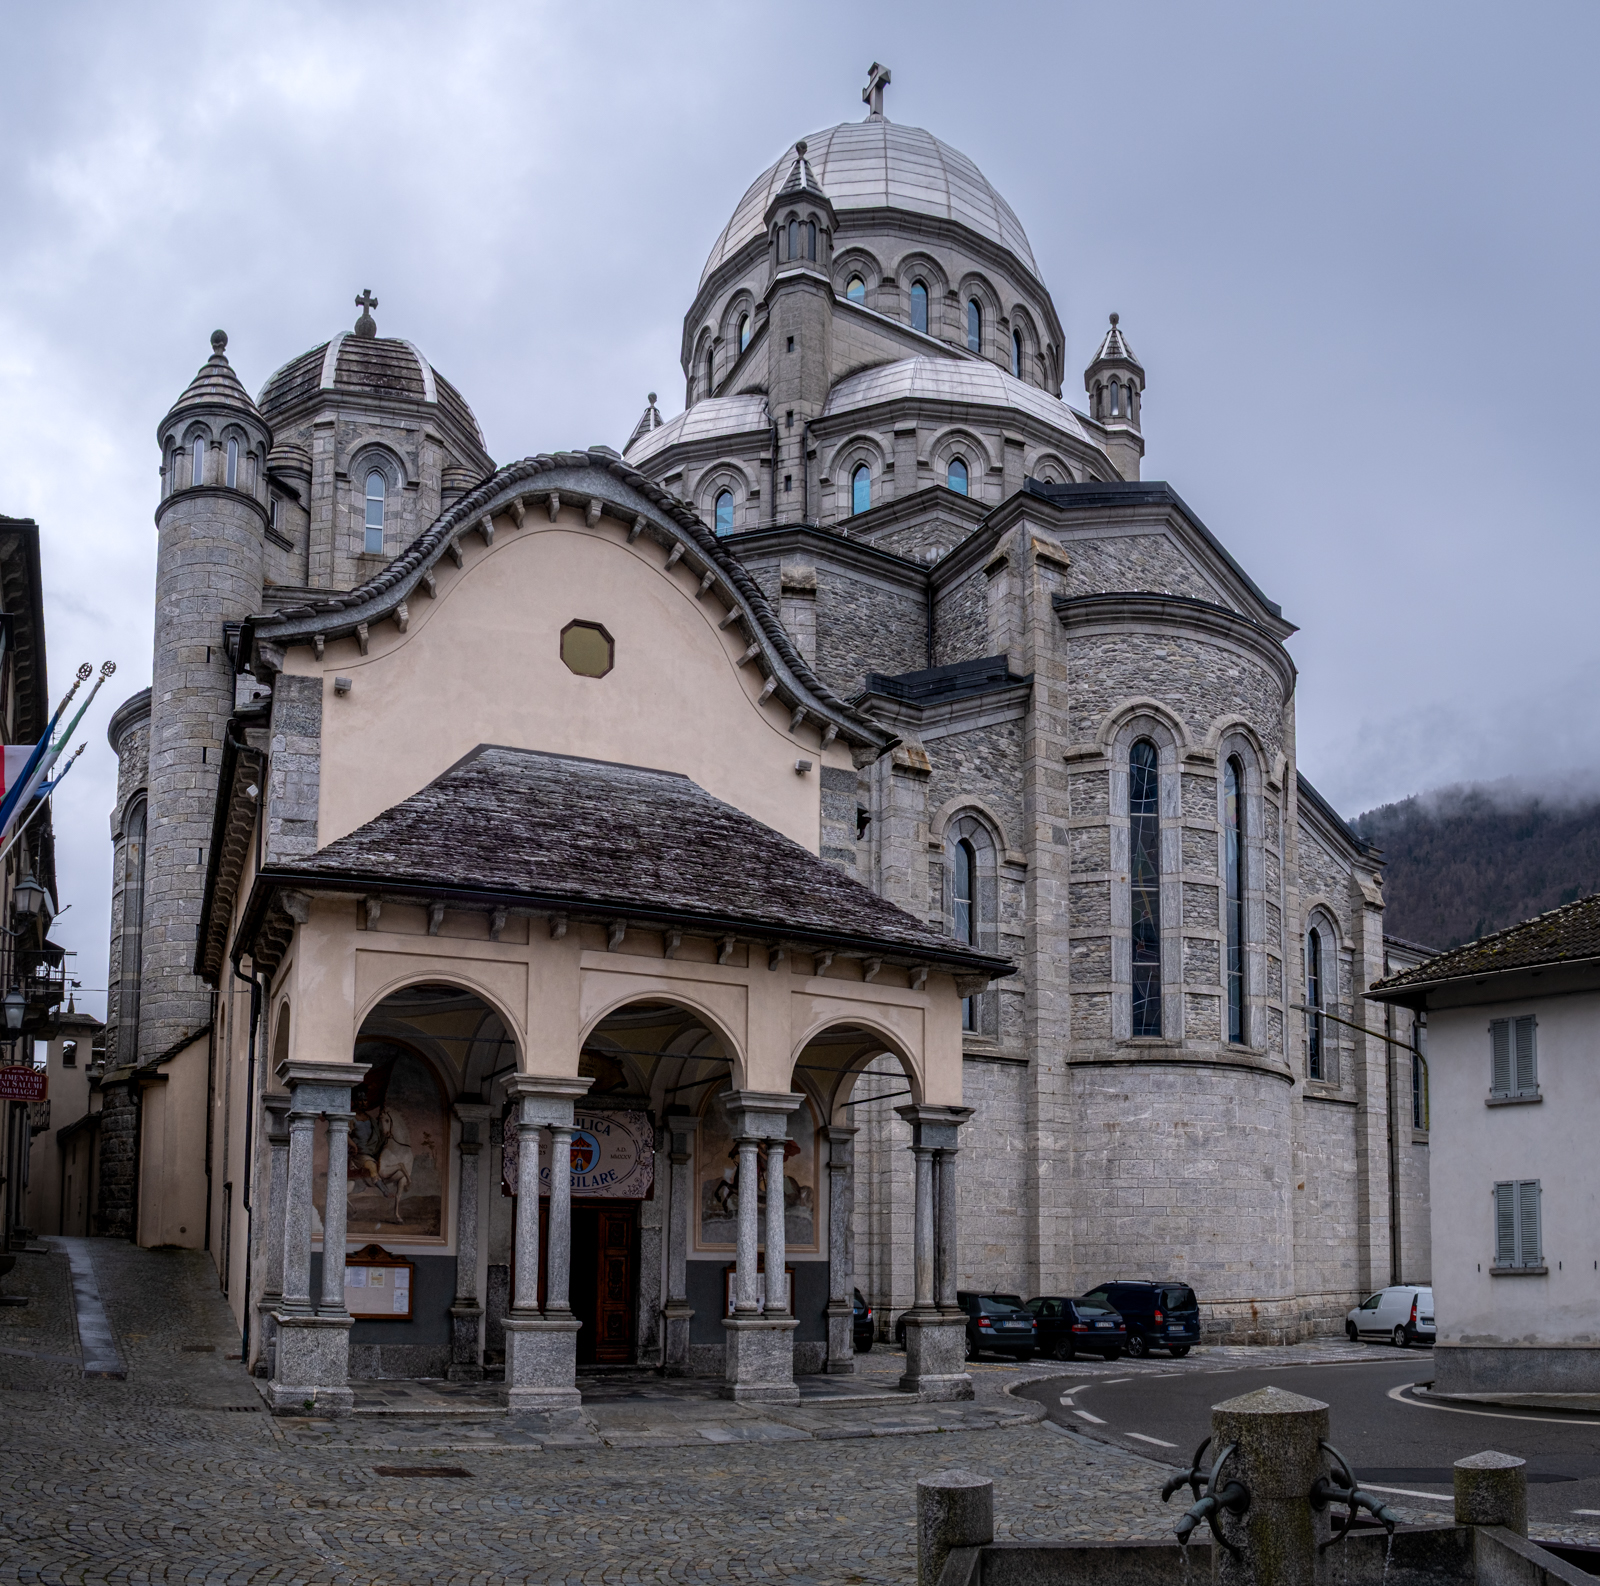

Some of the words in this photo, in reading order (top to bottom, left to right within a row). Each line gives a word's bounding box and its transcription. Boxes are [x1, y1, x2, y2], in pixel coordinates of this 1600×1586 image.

[0, 1074, 42, 1082] LIMENTARI
[12, 1080, 42, 1089] SALUMI
[573, 1118, 611, 1136] ILICA
[540, 1166, 619, 1187] GBILARE
